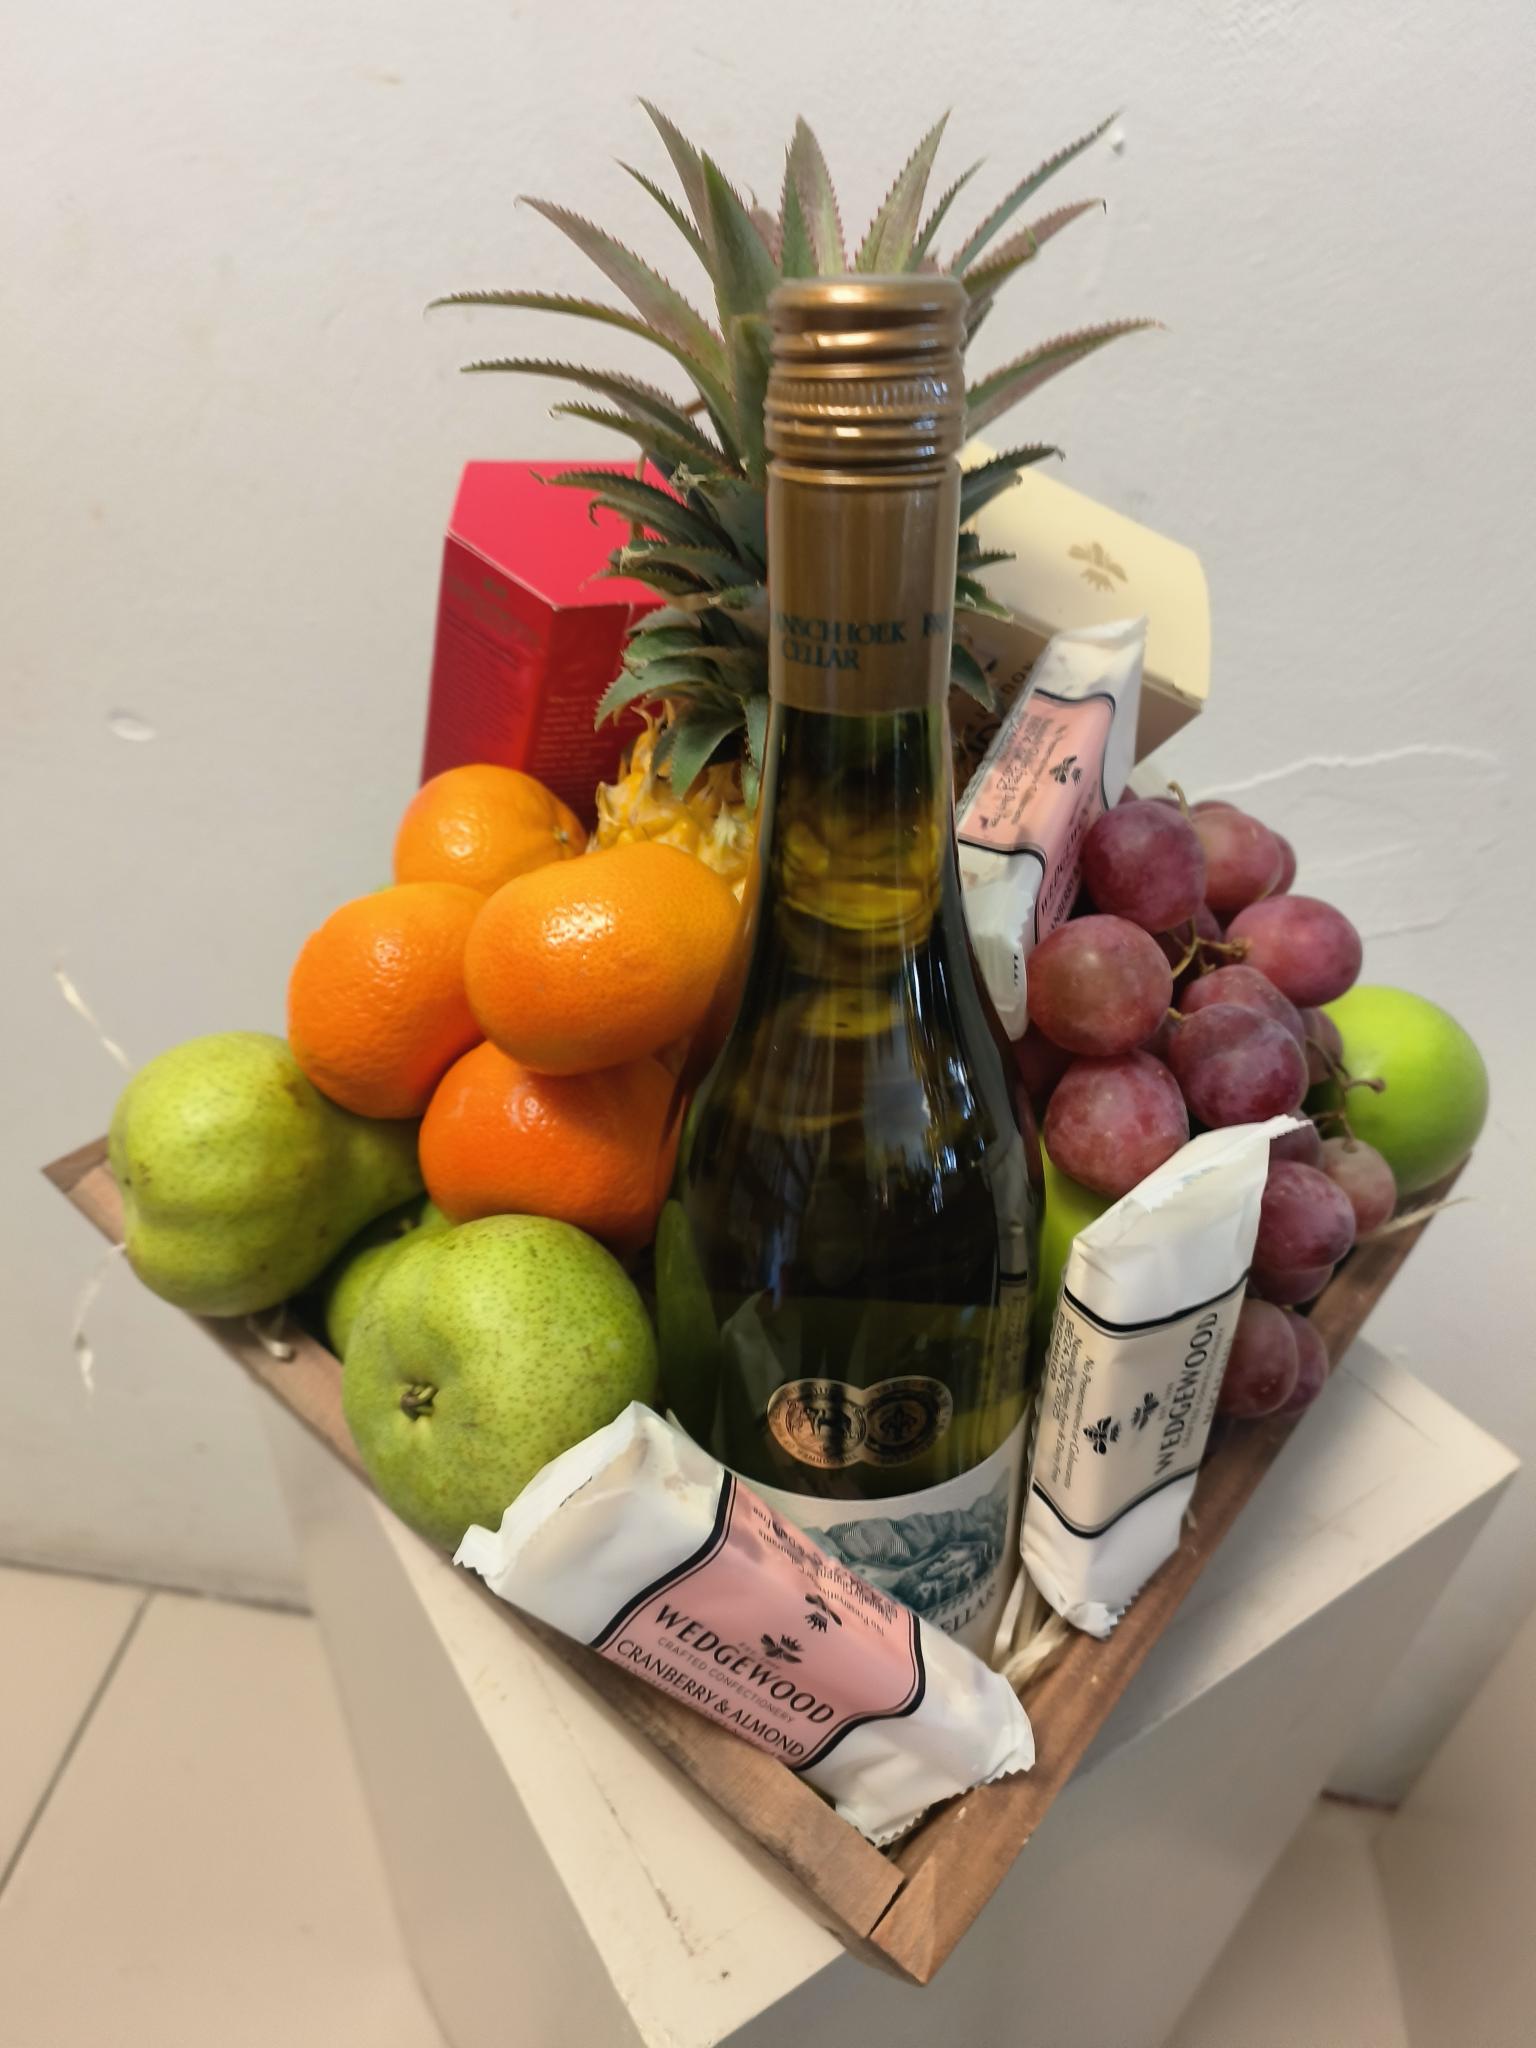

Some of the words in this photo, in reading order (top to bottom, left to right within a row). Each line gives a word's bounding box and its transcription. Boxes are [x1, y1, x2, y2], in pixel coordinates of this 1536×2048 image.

[782, 638, 860, 670] CELLAR
[1083, 1356, 1095, 1371] No
[1153, 1313, 1218, 1475] WEDGEWOOD
[614, 1637, 717, 1706] CRANBERRY
[712, 1697, 732, 1715] &
[726, 1704, 806, 1758] ALMOND
[653, 1602, 838, 1729] WEDGEWOOD
[656, 1635, 709, 1671] CRAFTED
[707, 1666, 795, 1725] CONFECTIONERY
